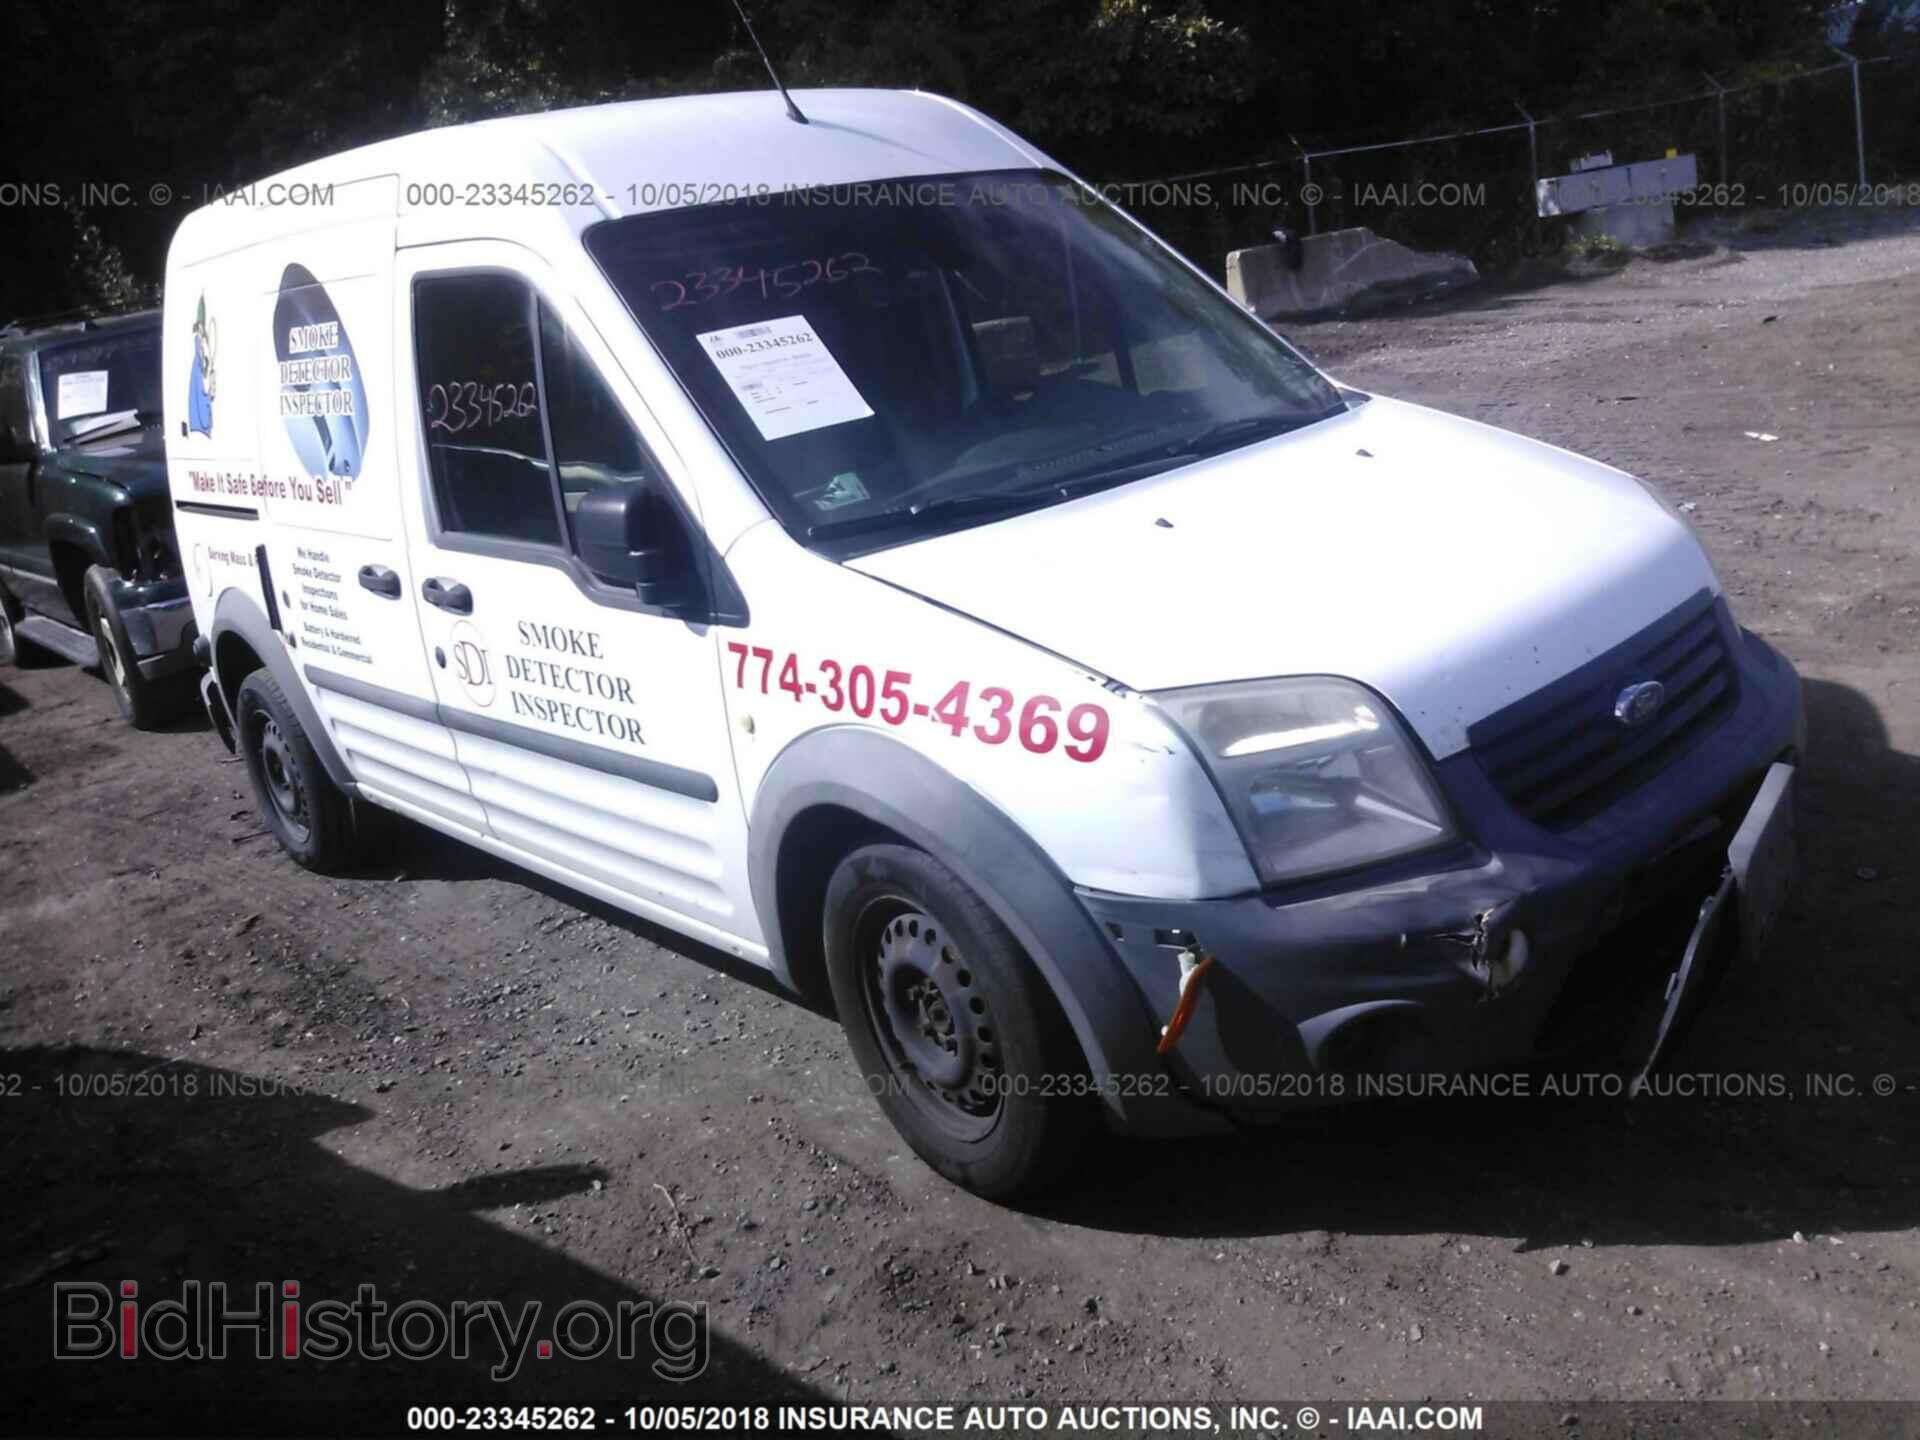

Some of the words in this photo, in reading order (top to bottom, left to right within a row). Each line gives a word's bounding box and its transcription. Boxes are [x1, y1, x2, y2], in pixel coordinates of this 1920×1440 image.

[651, 252, 883, 311] 23345262
[289, 323, 339, 352] SMOKE
[716, 332, 814, 360] 000-23345262
[280, 356, 352, 384] DETECTOR
[280, 390, 353, 416] INSPECTOR
[226, 473, 248, 495] Safe
[250, 474, 286, 498] Before
[288, 476, 313, 501] You
[517, 620, 604, 660] SMOKE
[506, 654, 635, 704] DETECTOR
[511, 690, 646, 745] INSPECTOR
[727, 641, 1111, 763] 774-305-4369
